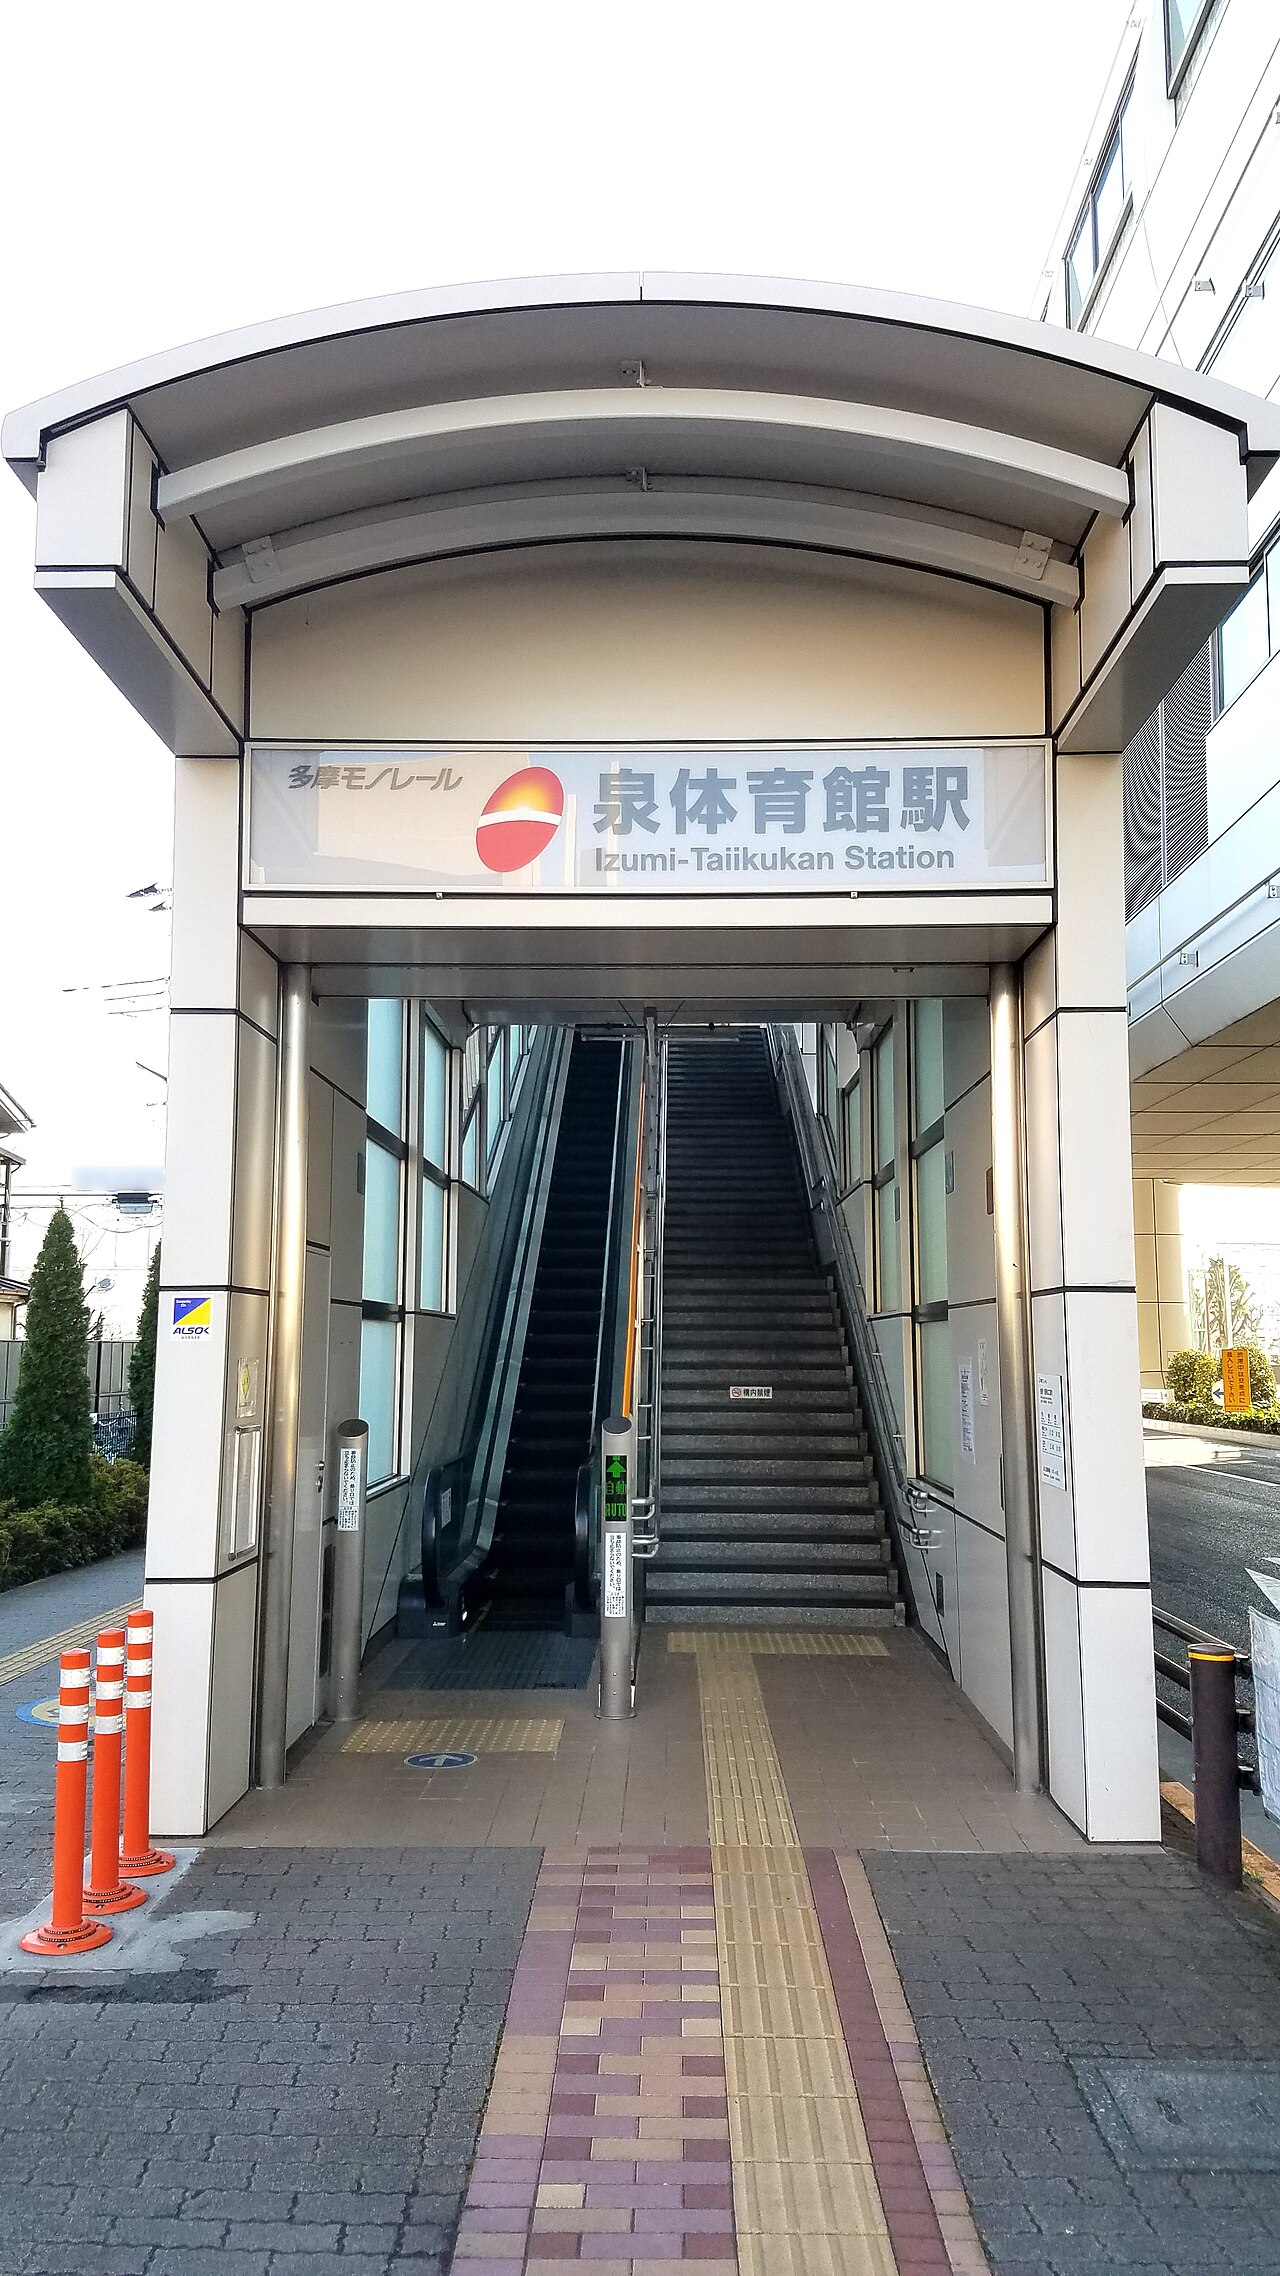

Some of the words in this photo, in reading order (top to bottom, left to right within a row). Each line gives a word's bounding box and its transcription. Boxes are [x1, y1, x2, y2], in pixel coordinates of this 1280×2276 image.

[288, 765, 463, 791] 多摩モノレール
[592, 766, 971, 835] 泉体育館駅
[595, 846, 834, 871] Izumi-Taiikukan
[845, 845, 954, 871] Station
[173, 1327, 210, 1335] ALSOK
[605, 1480, 628, 1495] 自動
[605, 1503, 627, 1517] AUTO
